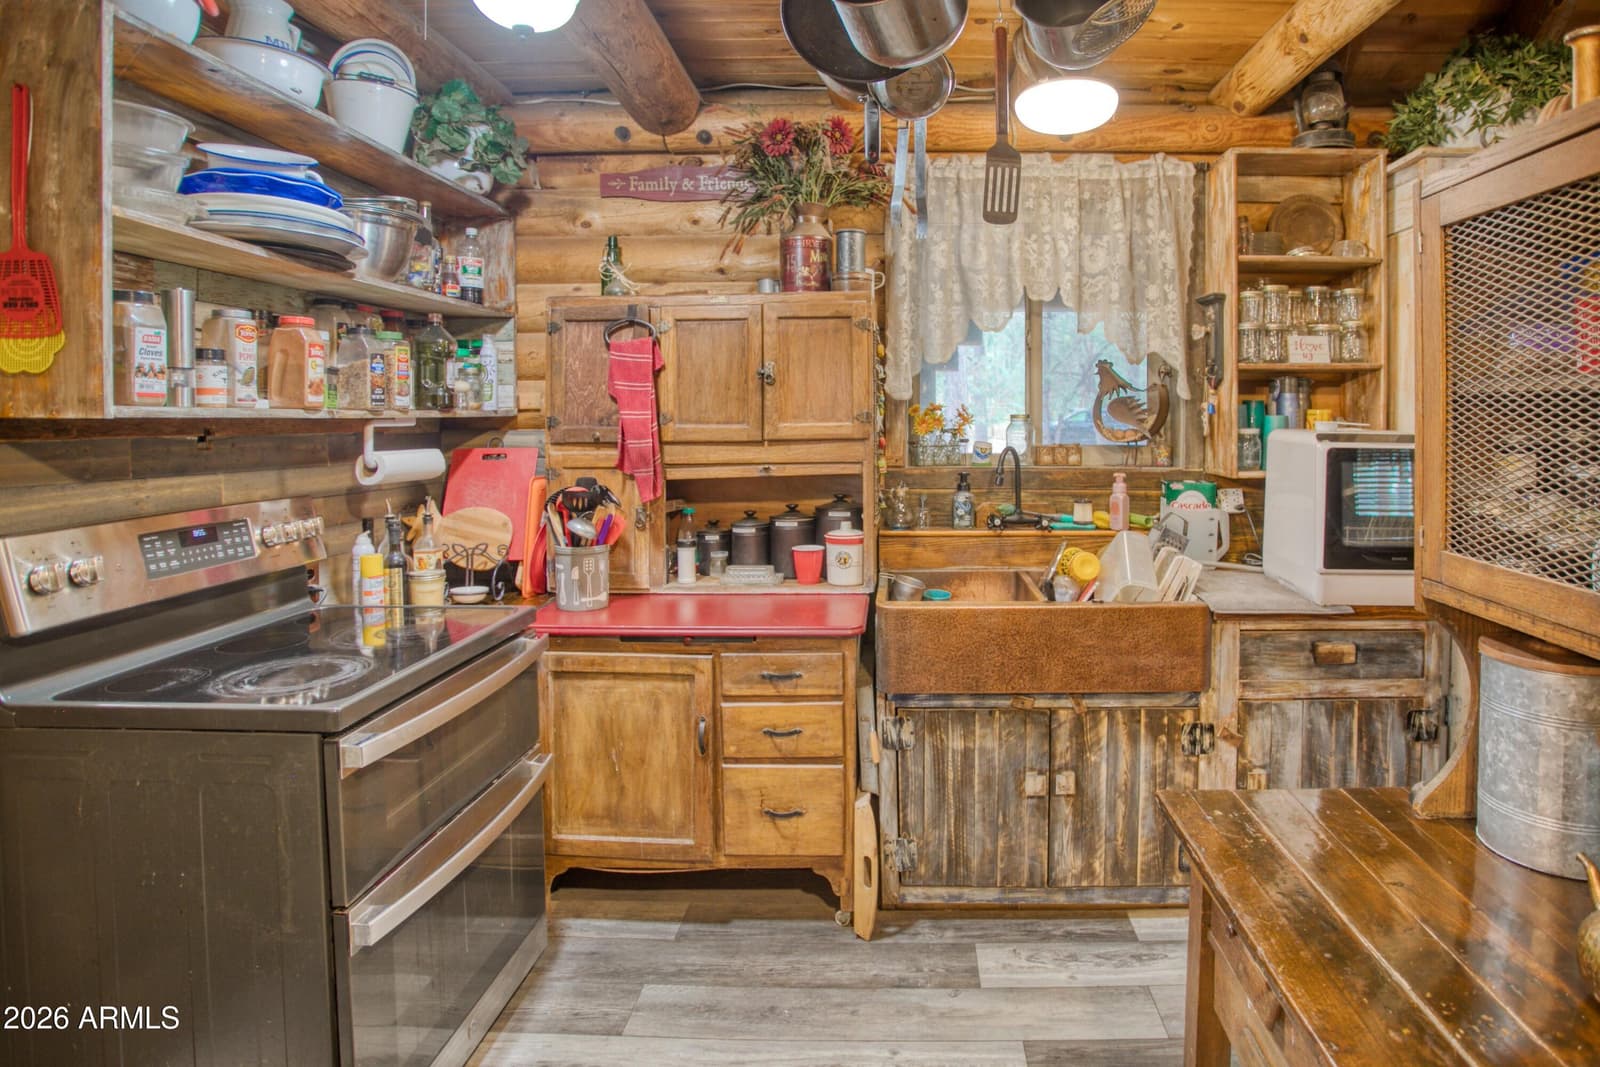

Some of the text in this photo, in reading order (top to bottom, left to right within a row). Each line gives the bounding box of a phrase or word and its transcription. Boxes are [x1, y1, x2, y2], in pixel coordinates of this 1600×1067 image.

[629, 175, 678, 197] Family
[681, 177, 694, 191] &
[138, 347, 163, 357] Cloves
[1170, 499, 1212, 511] Cascade
